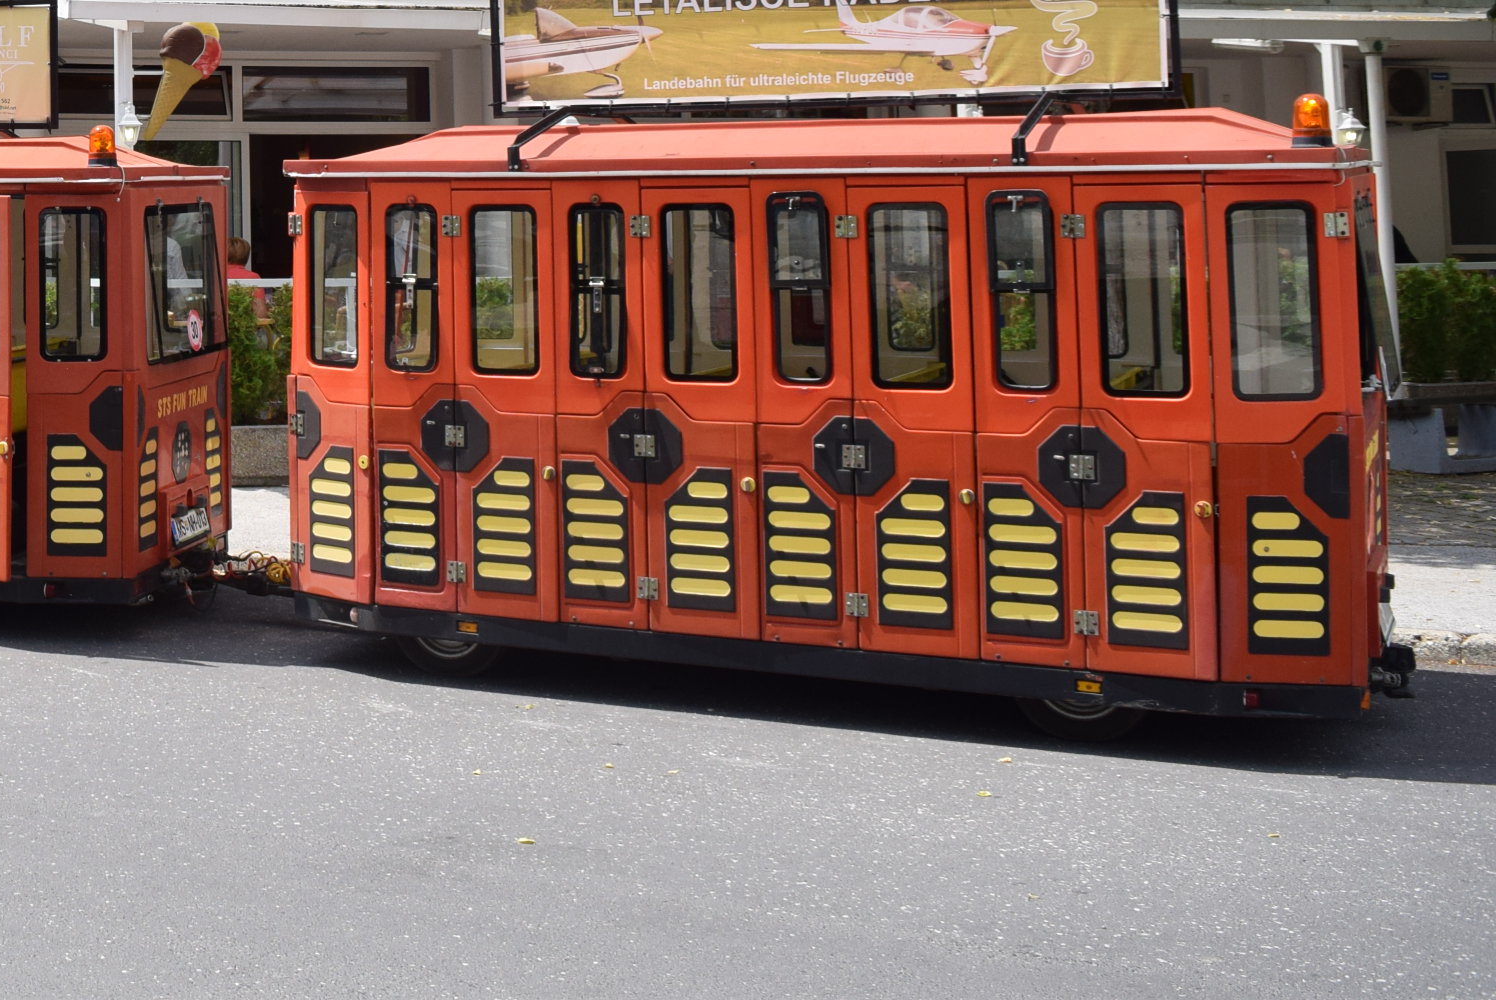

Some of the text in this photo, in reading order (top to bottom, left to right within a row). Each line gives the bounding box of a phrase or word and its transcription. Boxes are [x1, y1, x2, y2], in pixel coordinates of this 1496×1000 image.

[643, 71, 915, 90] Landebahn für ultraleichte Flugzeuge
[190, 320, 199, 339] 30
[157, 385, 208, 419] STS FUN TRAIN
